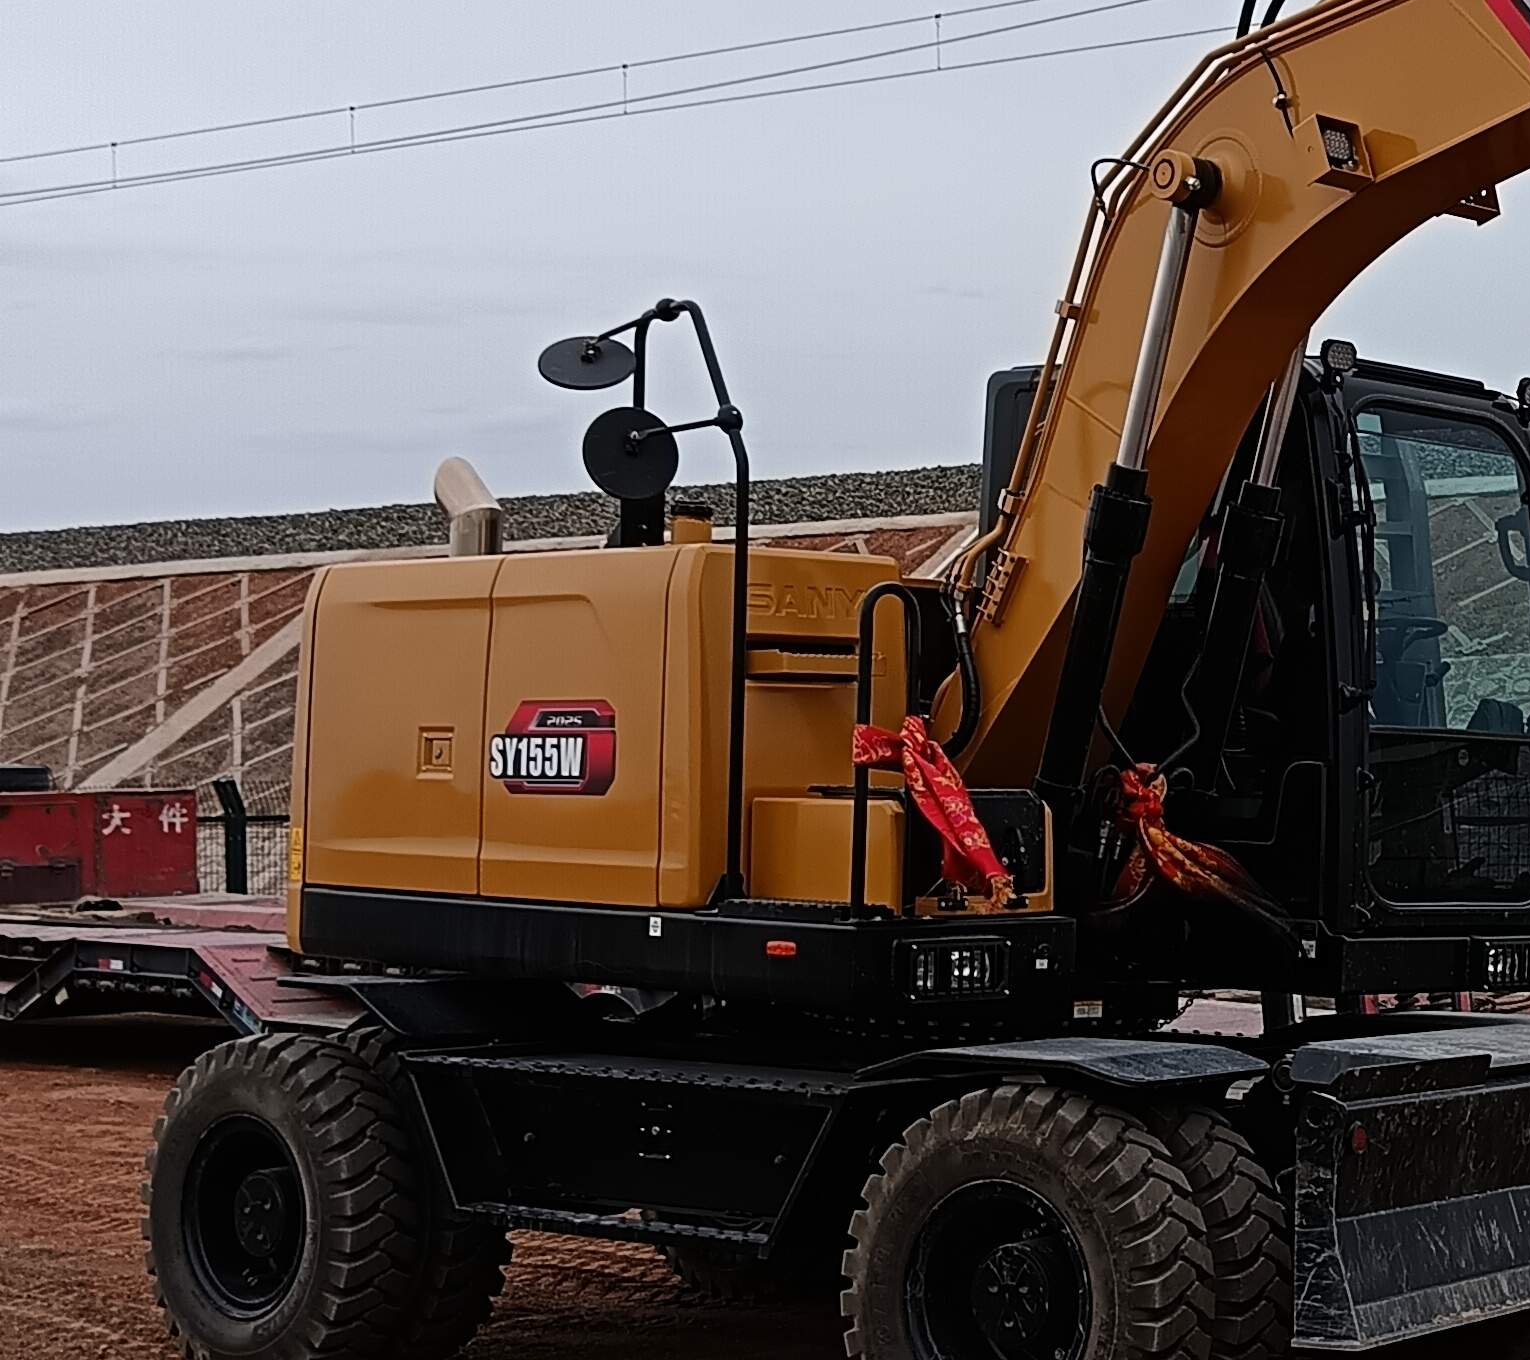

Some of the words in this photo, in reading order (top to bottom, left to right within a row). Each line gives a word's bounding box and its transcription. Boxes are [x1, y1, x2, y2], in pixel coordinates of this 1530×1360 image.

[747, 583, 864, 618] SANY
[546, 715, 583, 726] 2025
[490, 736, 583, 777] SY155W
